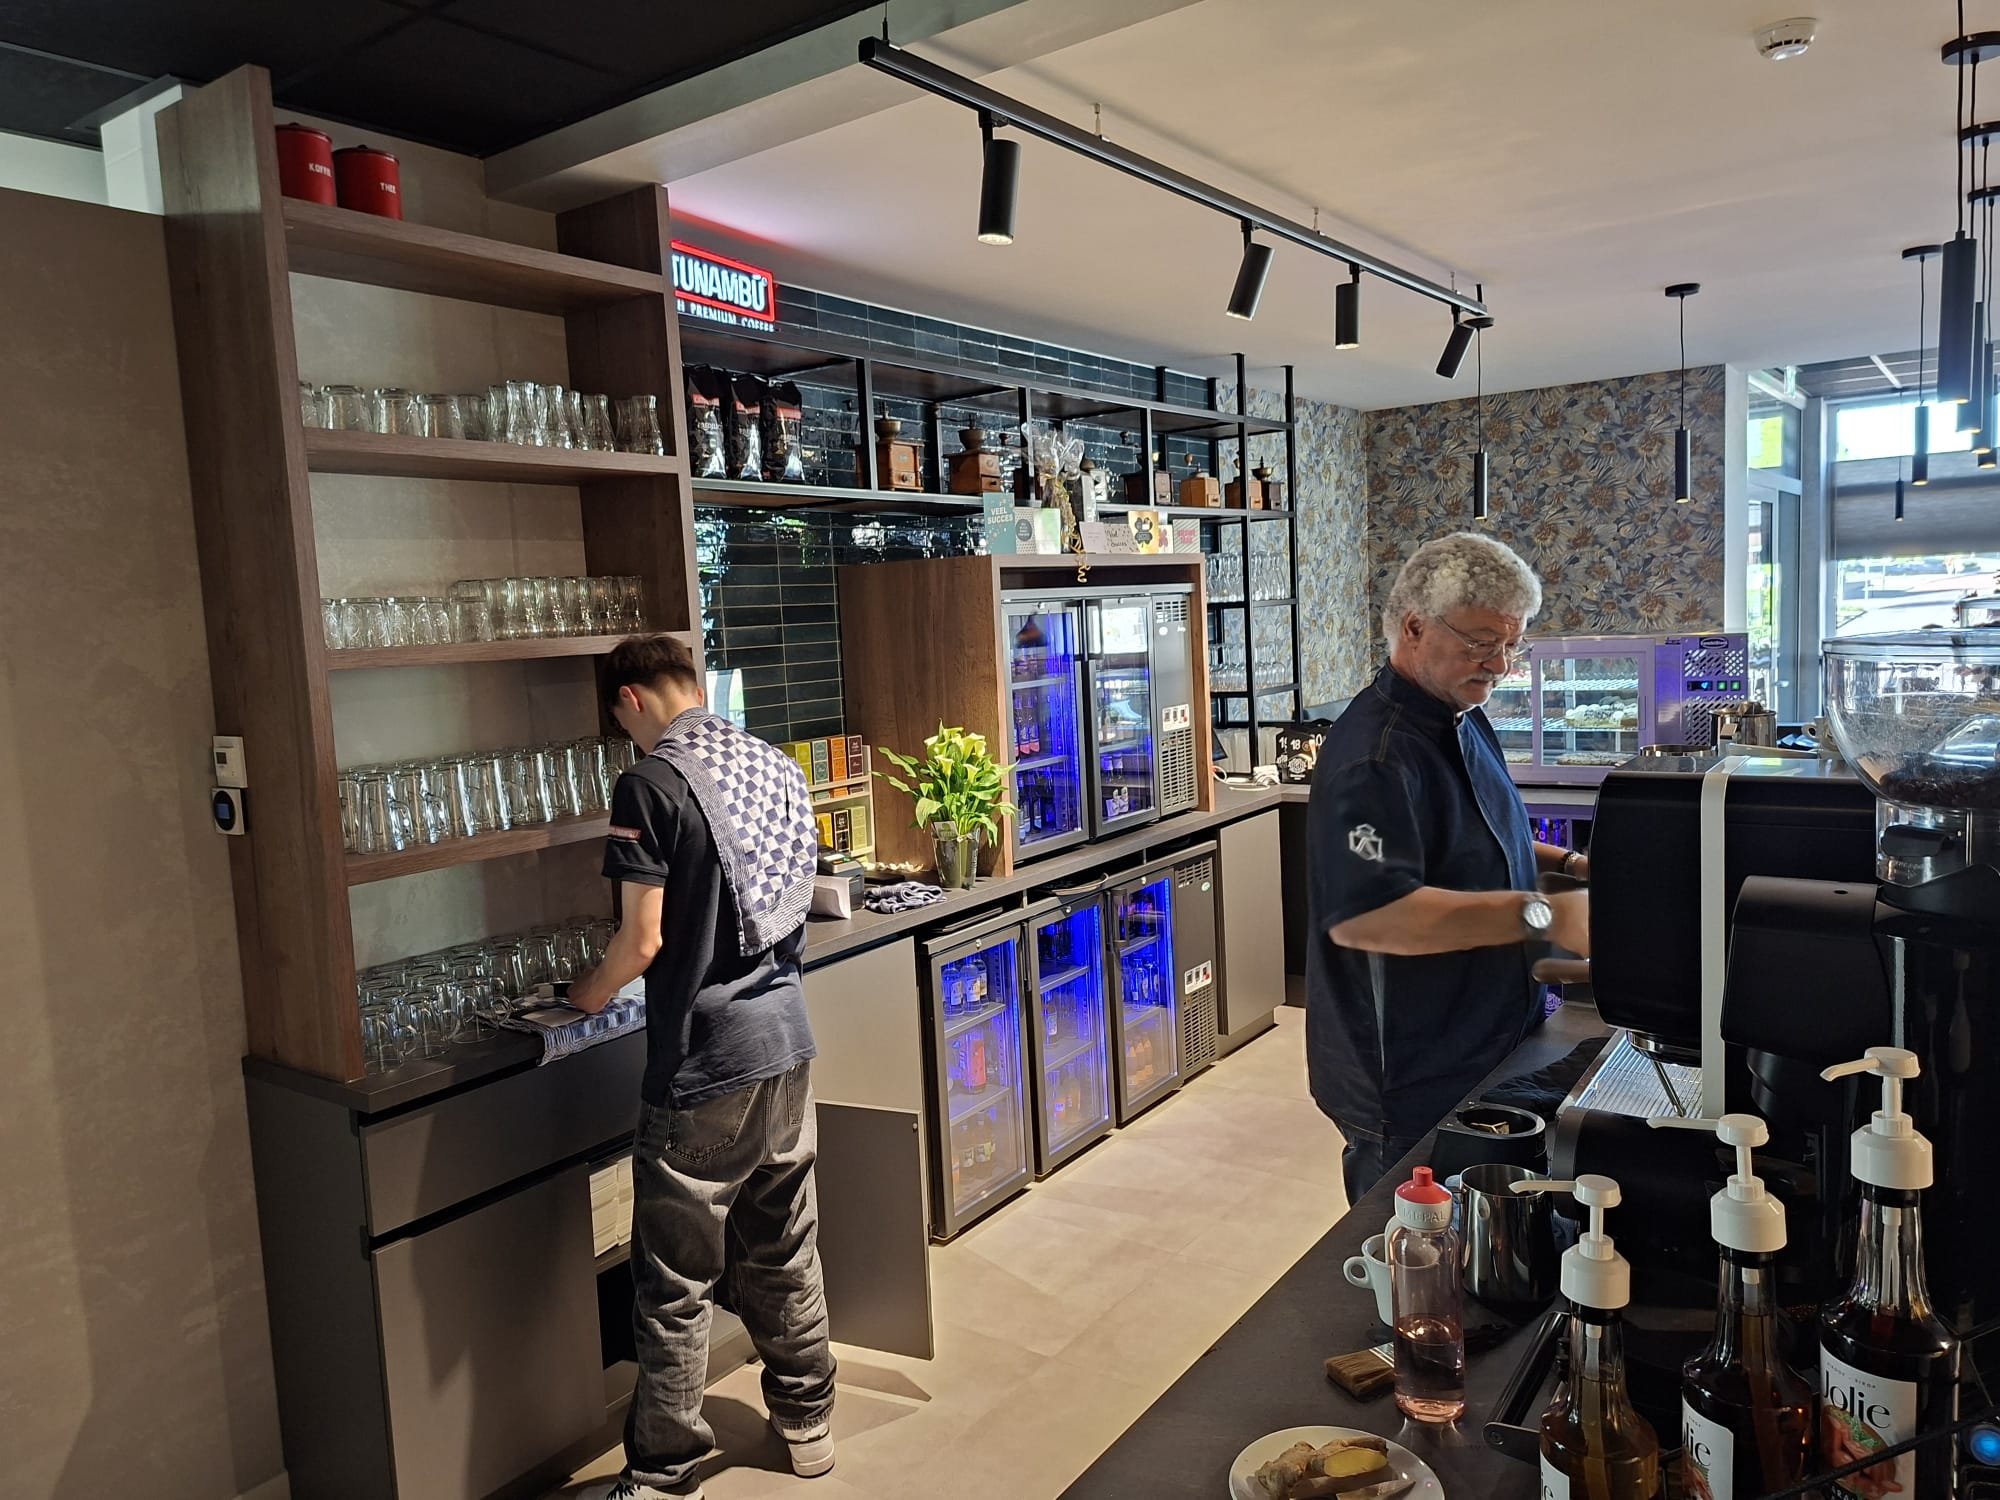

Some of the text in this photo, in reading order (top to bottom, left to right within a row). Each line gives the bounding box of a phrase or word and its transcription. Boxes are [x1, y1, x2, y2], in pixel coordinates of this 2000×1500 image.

[690, 303, 737, 324] PREMIUM
[741, 317, 775, 332] COFFEE
[990, 507, 1007, 516] VEEL
[987, 514, 1014, 525] SUCCES
[1290, 738, 1301, 751] 18
[1823, 1369, 1891, 1429] Jolie
